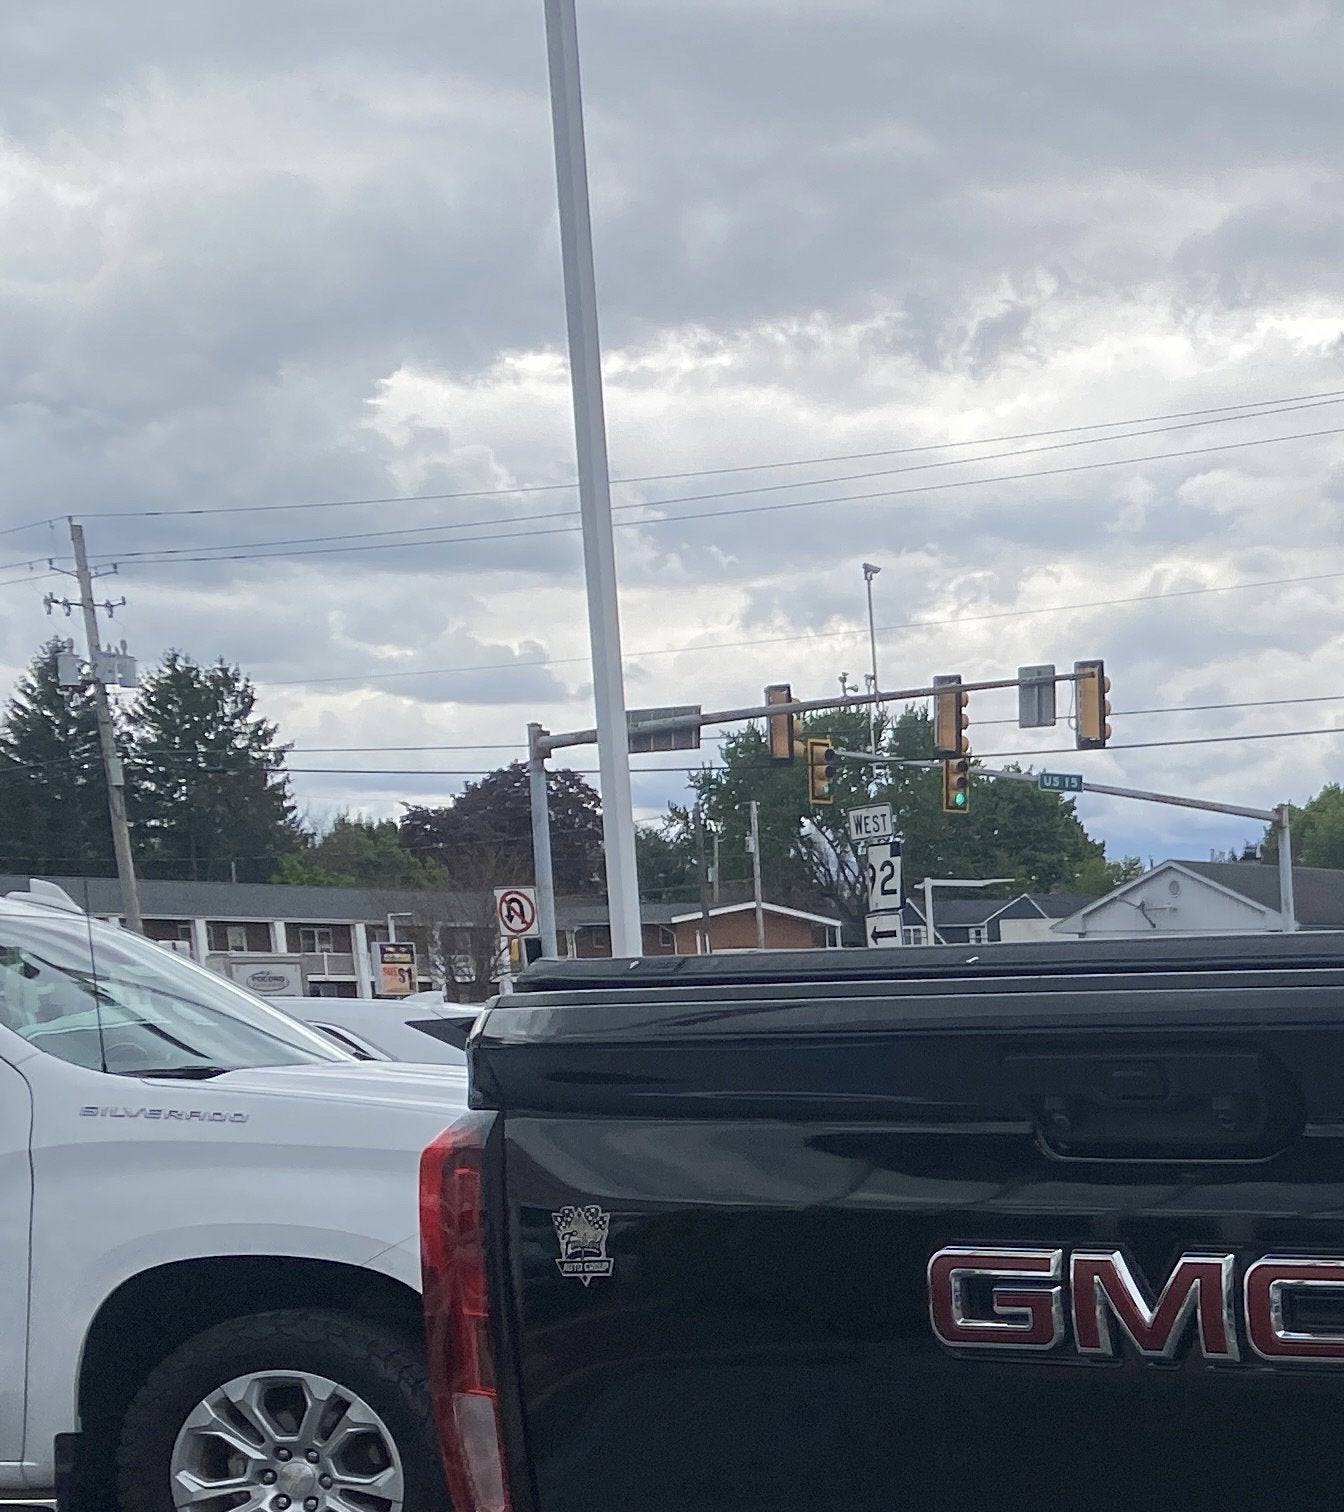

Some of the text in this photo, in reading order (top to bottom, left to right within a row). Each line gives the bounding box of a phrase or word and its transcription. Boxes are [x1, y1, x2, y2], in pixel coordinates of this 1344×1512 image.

[1043, 775, 1078, 788] US 15
[853, 813, 887, 836] WEST
[79, 1105, 250, 1124] SILVERADO
